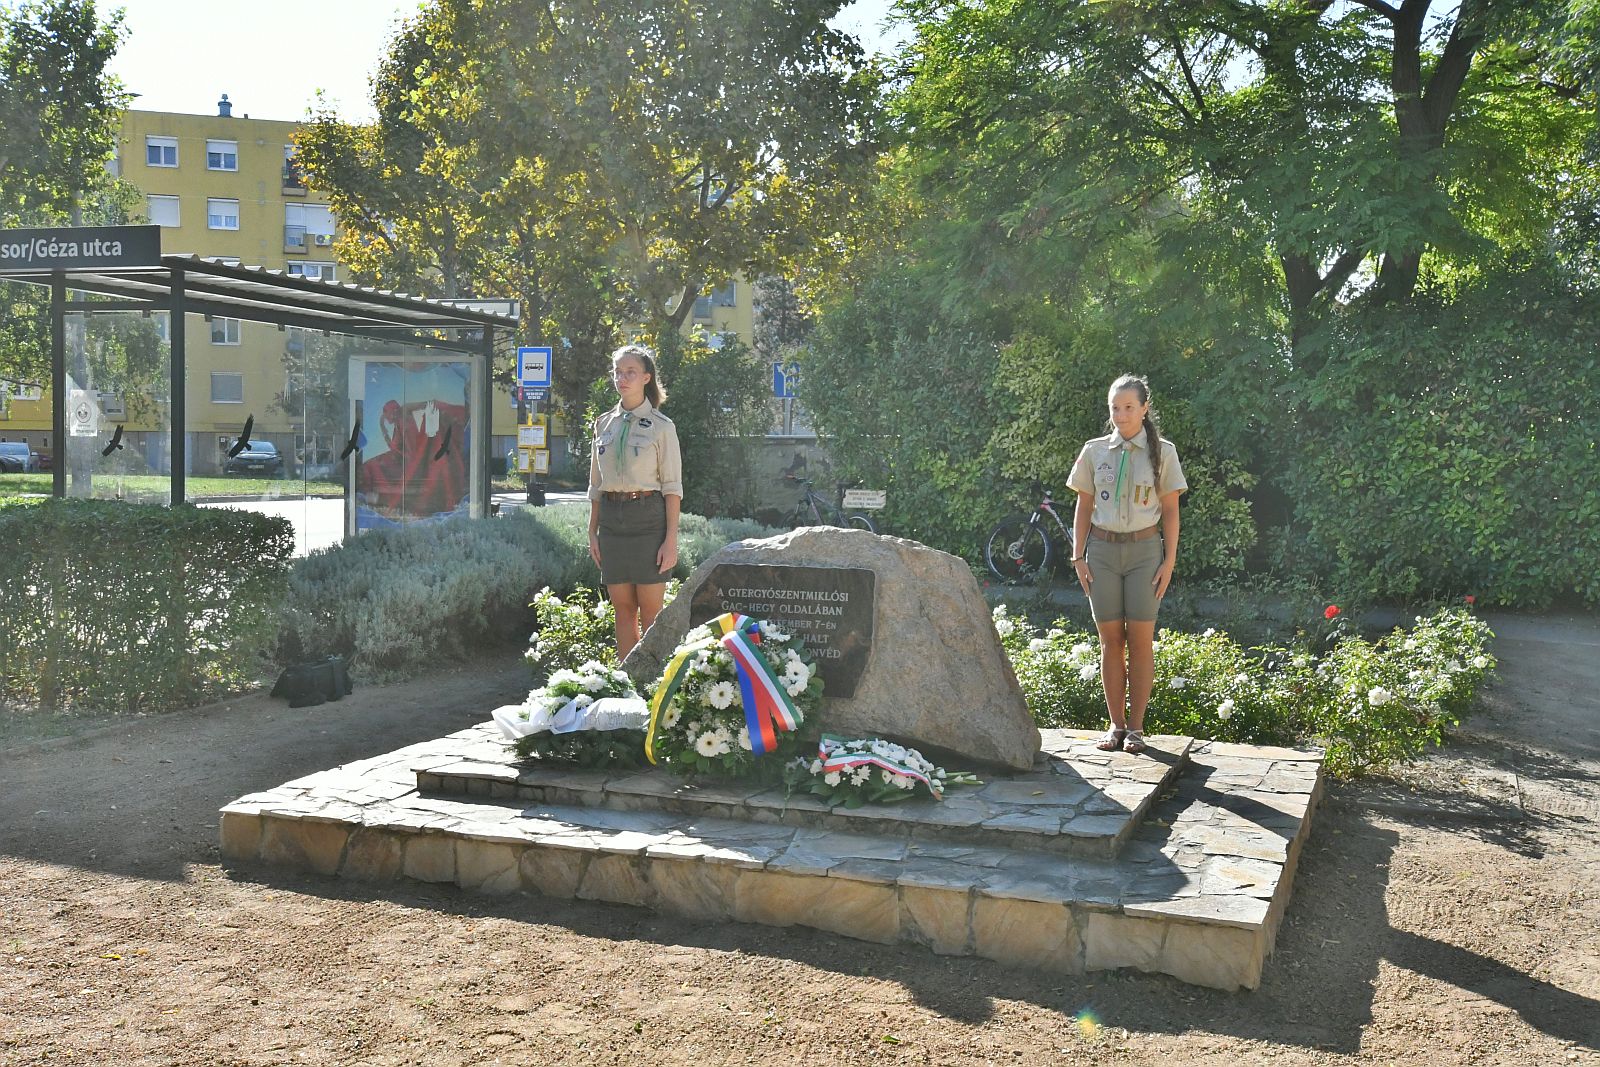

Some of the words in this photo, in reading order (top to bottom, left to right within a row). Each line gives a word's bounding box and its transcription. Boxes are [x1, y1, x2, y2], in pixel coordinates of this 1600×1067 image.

[1, 237, 78, 262] sor/Géza
[83, 238, 122, 257] utca
[716, 587, 724, 597] A
[728, 588, 849, 602] GYERGYÓSZENTMIKLÓSI
[721, 600, 776, 614] GAC-HEGY
[779, 603, 843, 616] OLDALÁBAN
[815, 619, 837, 630] 7-ÉN
[803, 633, 830, 644] HALT
[806, 646, 841, 659] ONVÉD
